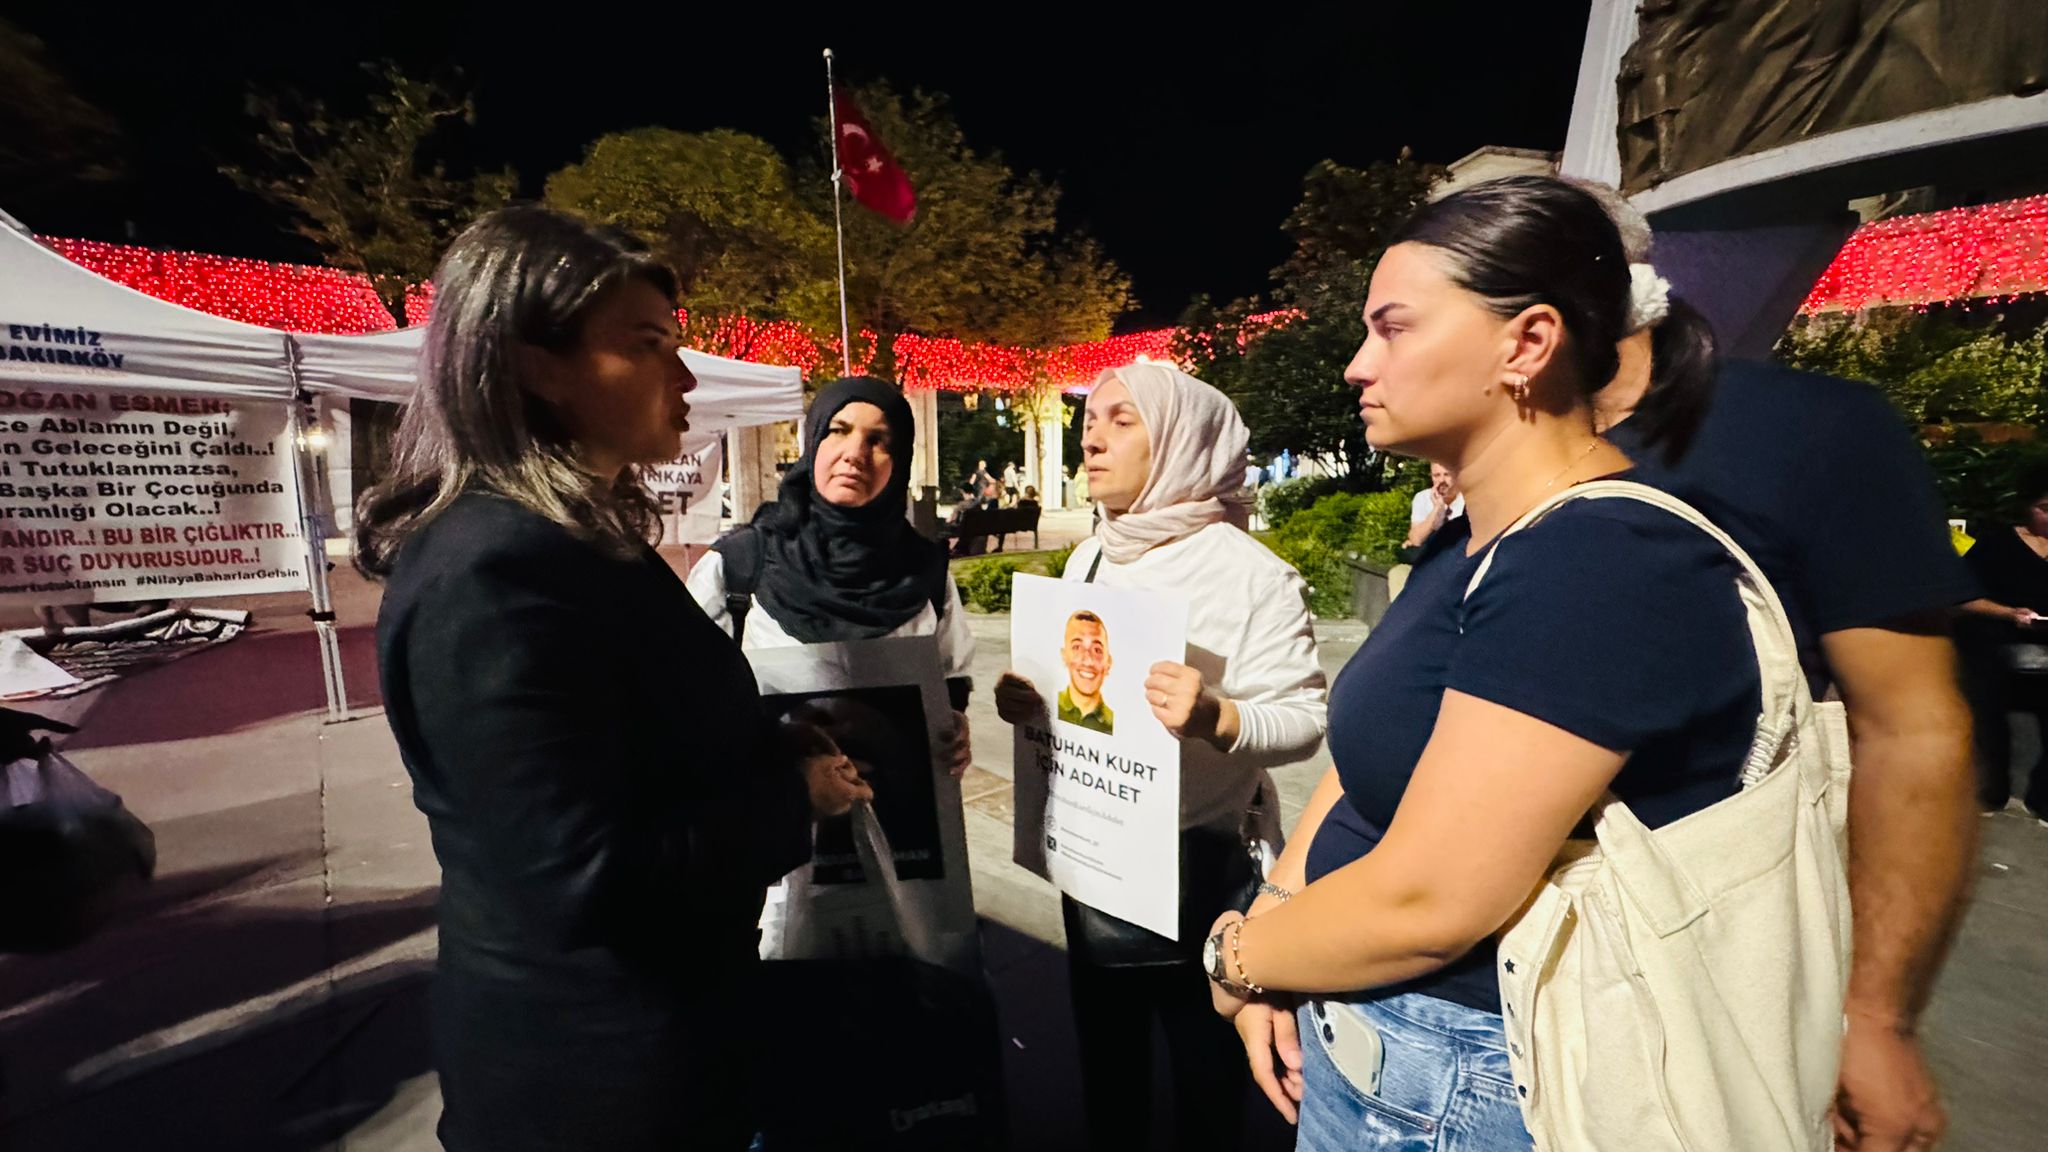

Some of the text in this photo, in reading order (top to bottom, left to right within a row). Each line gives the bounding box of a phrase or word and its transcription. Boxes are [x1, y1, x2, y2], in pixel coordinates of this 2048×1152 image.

[9, 323, 101, 346] EVİMİZ
[40, 418, 154, 435] Ablamın
[163, 421, 236, 438] Değil,
[32, 439, 182, 458] Geleceğini
[190, 442, 275, 458] Çaldı..!
[20, 461, 238, 477] Tutuklanmazsa,
[0, 480, 284, 501] Başka Bir Çocuğunda
[0, 502, 220, 521] ranlığı Olacak..!
[103, 527, 133, 545] BU
[140, 523, 178, 544] BİR
[184, 522, 299, 546] ÇIĞLIKTIR..!
[23, 553, 74, 576] SUÇ
[81, 547, 260, 570] DUYURUSUDUR..!
[1024, 725, 1158, 782] BATUHAN KURT
[1069, 768, 1141, 803] ADALET
